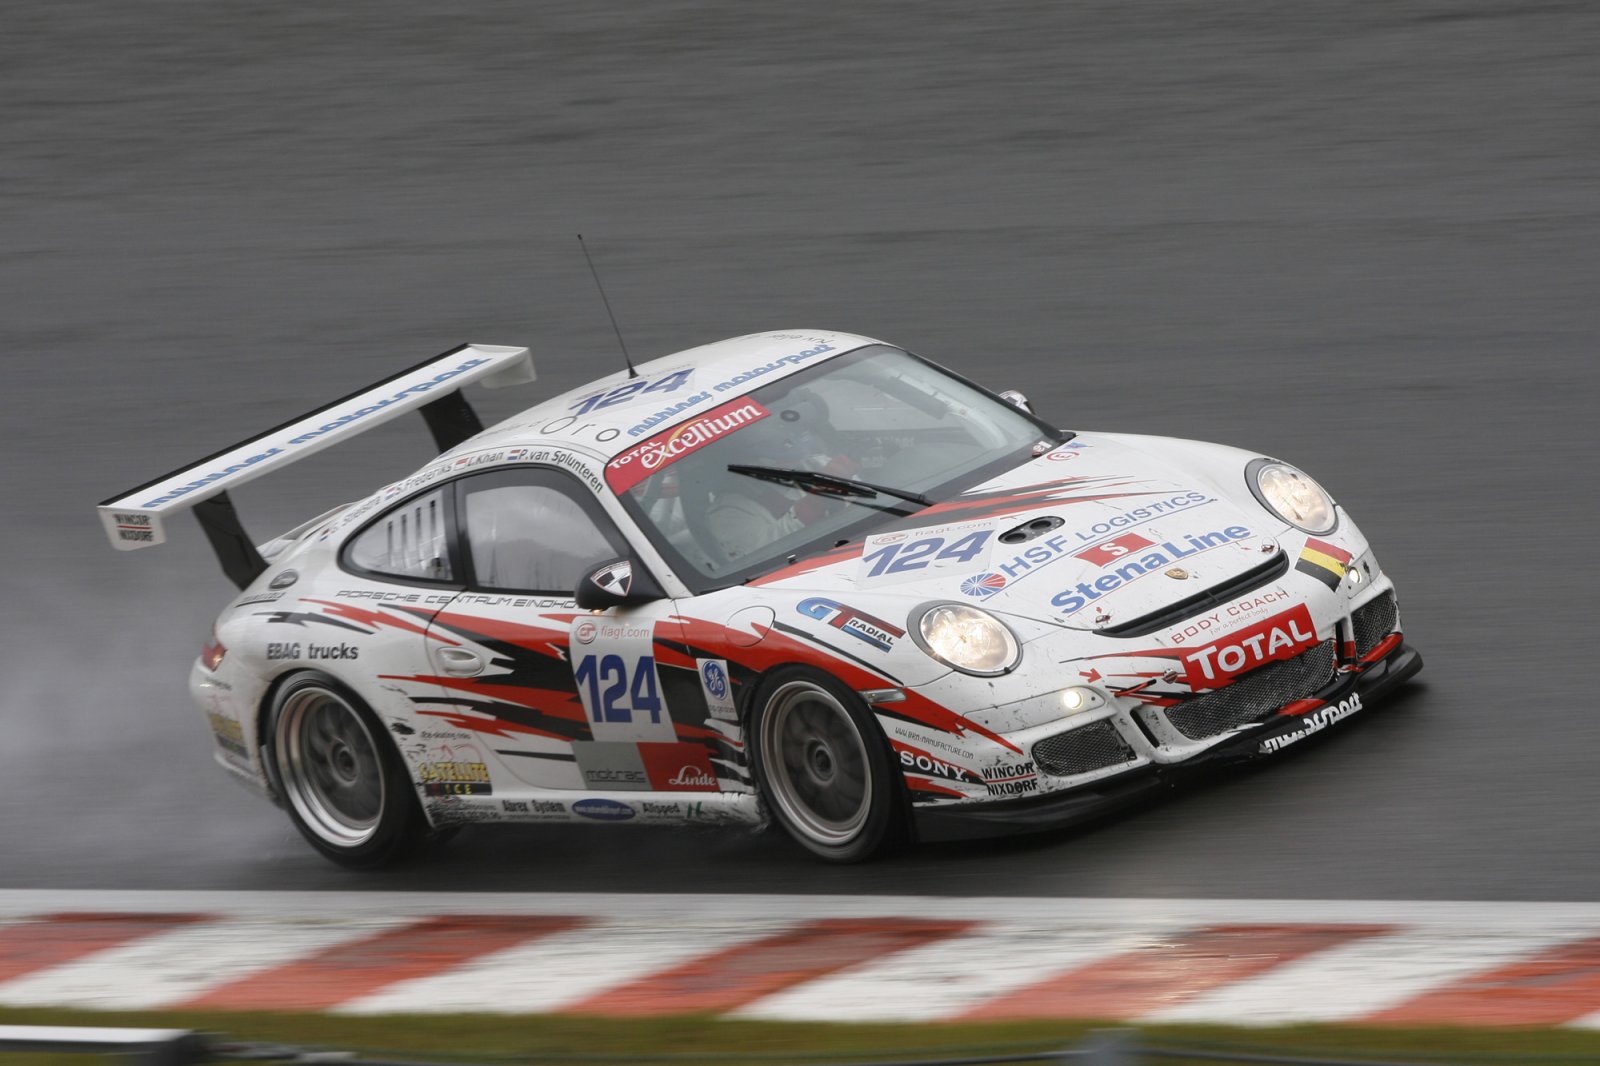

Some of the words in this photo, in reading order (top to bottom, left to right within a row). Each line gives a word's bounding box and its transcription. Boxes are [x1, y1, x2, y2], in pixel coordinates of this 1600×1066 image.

[568, 367, 696, 417] 124
[607, 441, 662, 469] TOTAL
[641, 404, 762, 469] excellium
[552, 450, 604, 493] Splunteren
[862, 529, 995, 578] 124
[999, 535, 1067, 578] HSF
[1075, 491, 1209, 542] LOGISTICS
[1100, 541, 1129, 557] S
[1050, 552, 1170, 614] Stena
[1161, 525, 1251, 560] Line
[336, 590, 419, 603] PORSCHE
[424, 594, 512, 607] CENTRUM
[1171, 613, 1221, 644] BODY
[1226, 589, 1290, 616] COACH
[266, 642, 301, 661] EBAG
[308, 642, 360, 661] trucks
[848, 619, 894, 646] RADIAL
[1187, 619, 1312, 680] TOTAL
[575, 654, 662, 724] 124
[668, 765, 717, 786] Linde
[981, 762, 1035, 782] WINCOR
[986, 778, 1039, 797] NIXDORF
